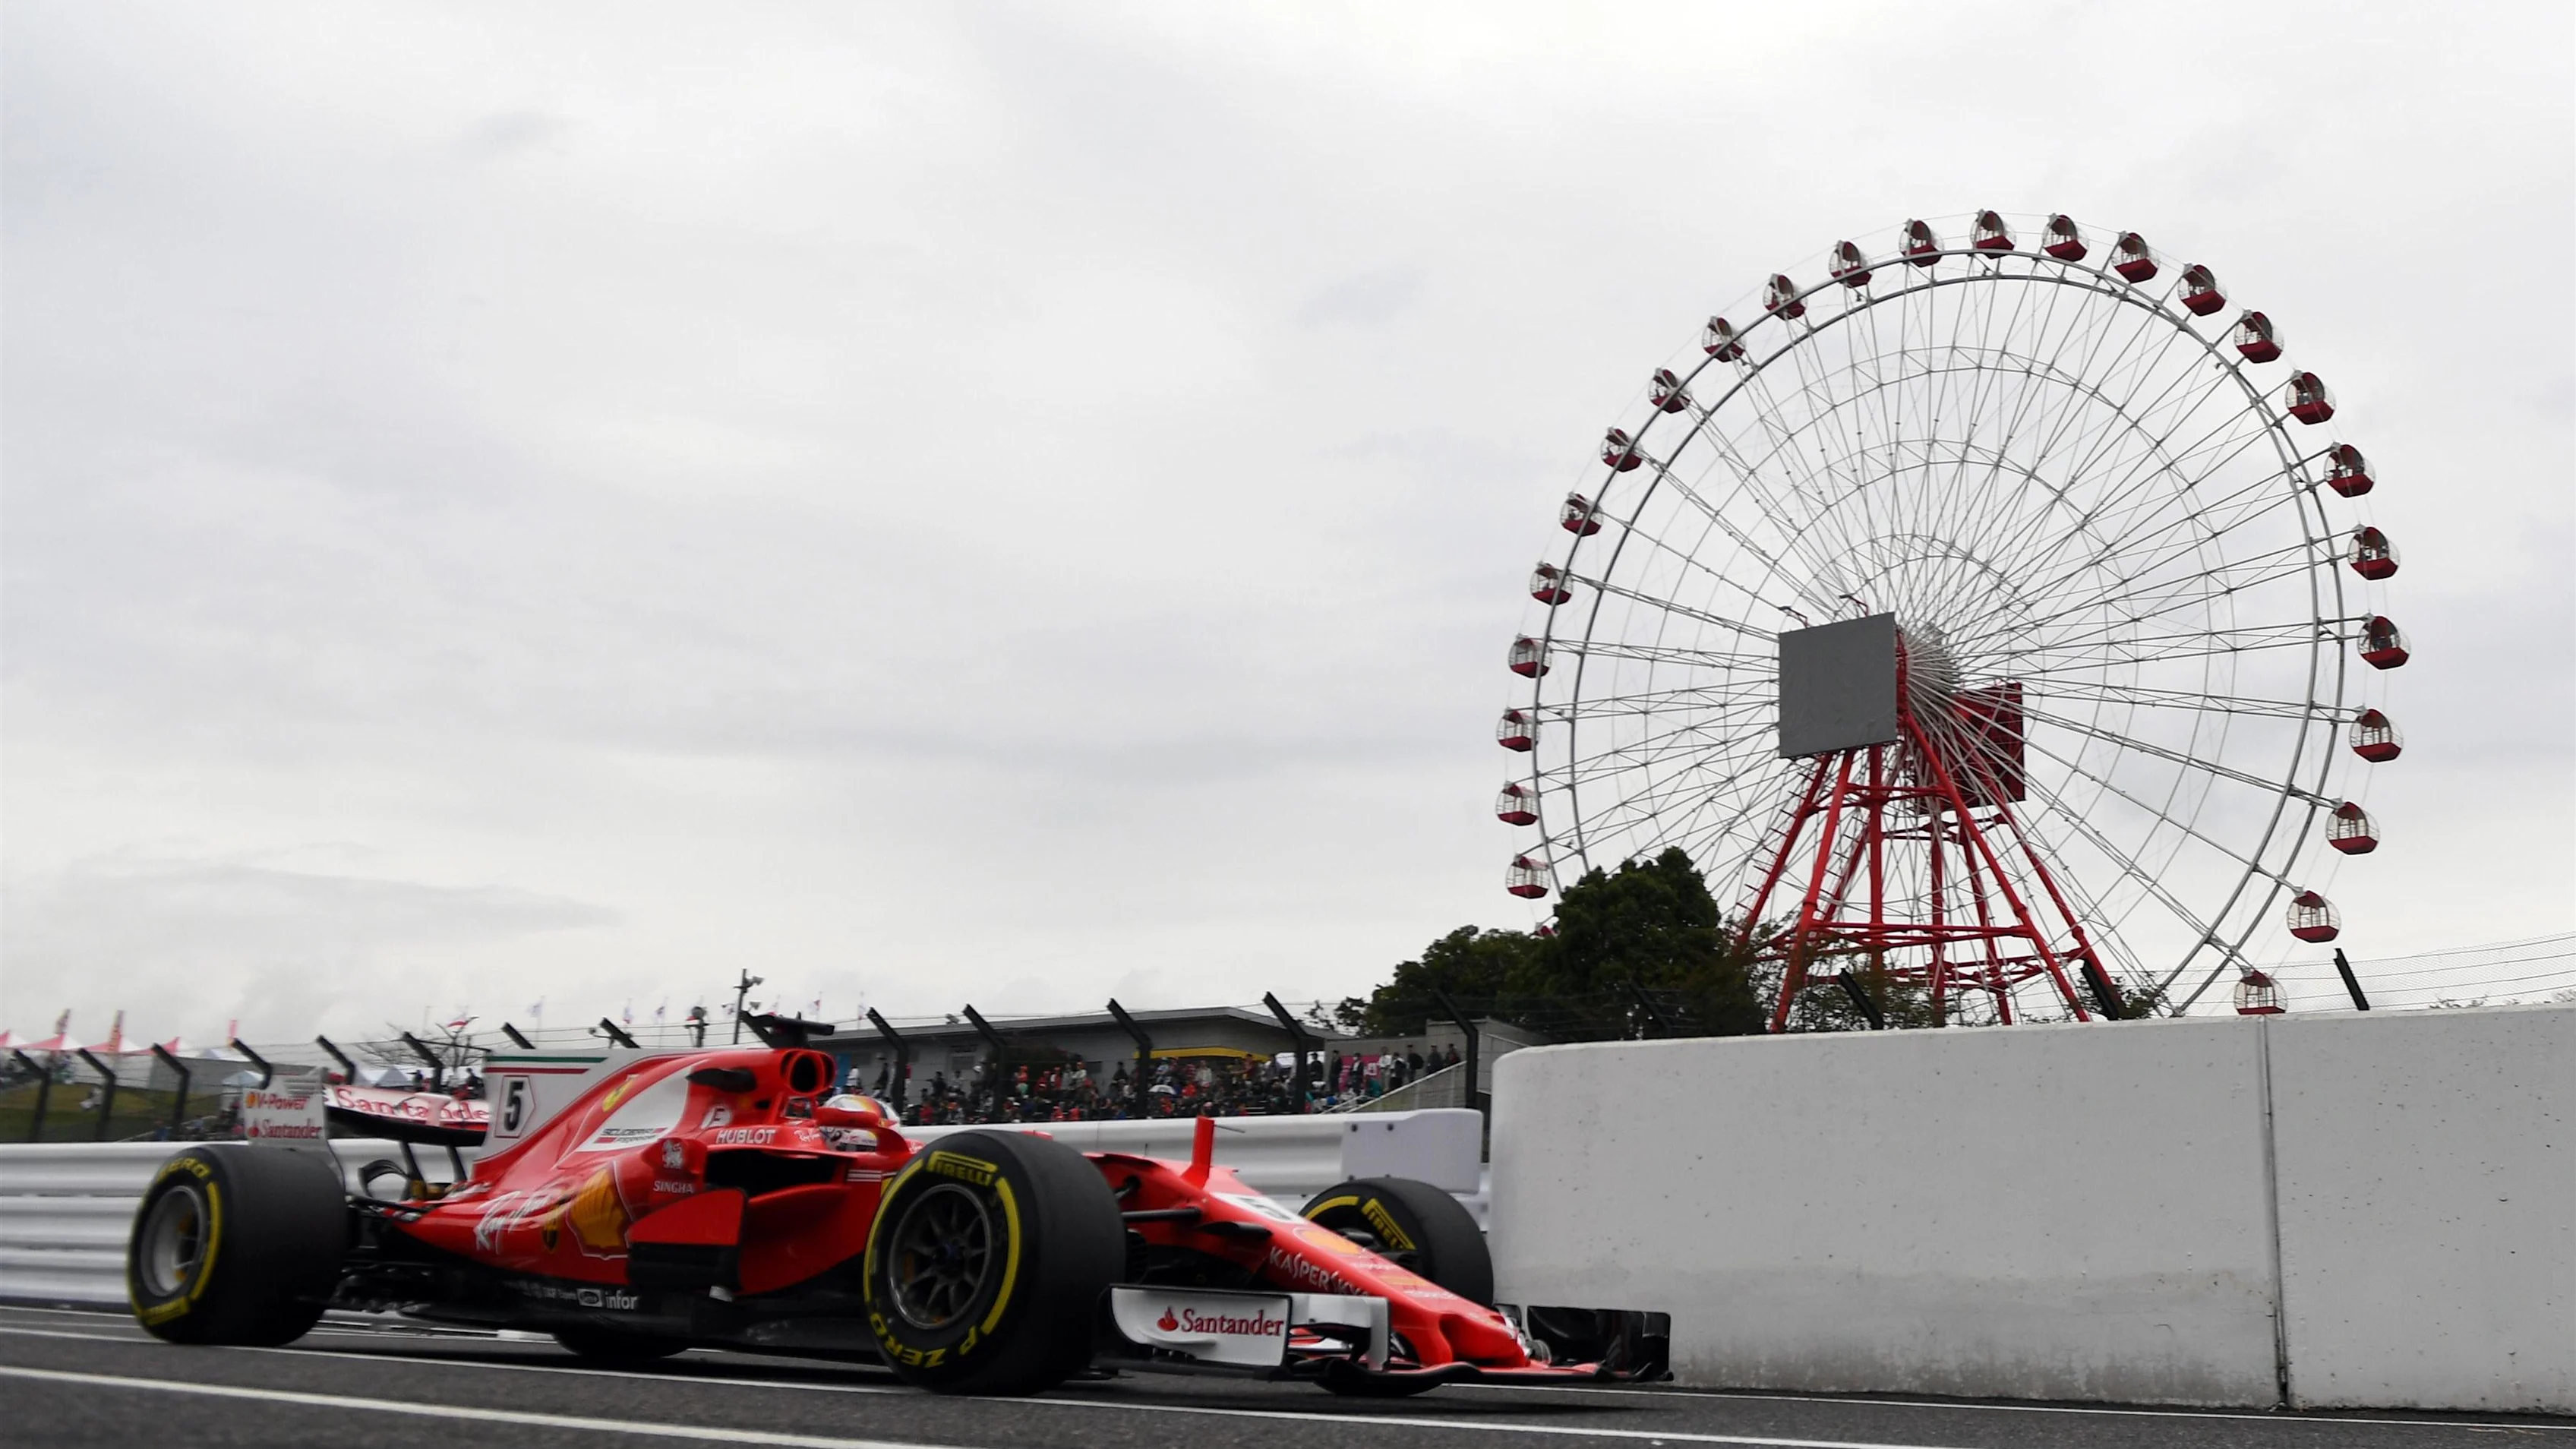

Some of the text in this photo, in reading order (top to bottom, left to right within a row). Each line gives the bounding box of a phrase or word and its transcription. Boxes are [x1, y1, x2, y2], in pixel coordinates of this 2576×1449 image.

[335, 1088, 491, 1122] Santande
[503, 1081, 524, 1131] 5
[261, 1117, 322, 1138] Santander
[716, 1129, 776, 1144] HUBLOT
[926, 1151, 999, 1186] PIRELLI
[653, 1180, 693, 1194] SINGHA
[1361, 1197, 1417, 1251] PIREL
[605, 1290, 639, 1310] infor
[1181, 1308, 1284, 1337] Santander
[870, 1312, 977, 1368] P ZERO
